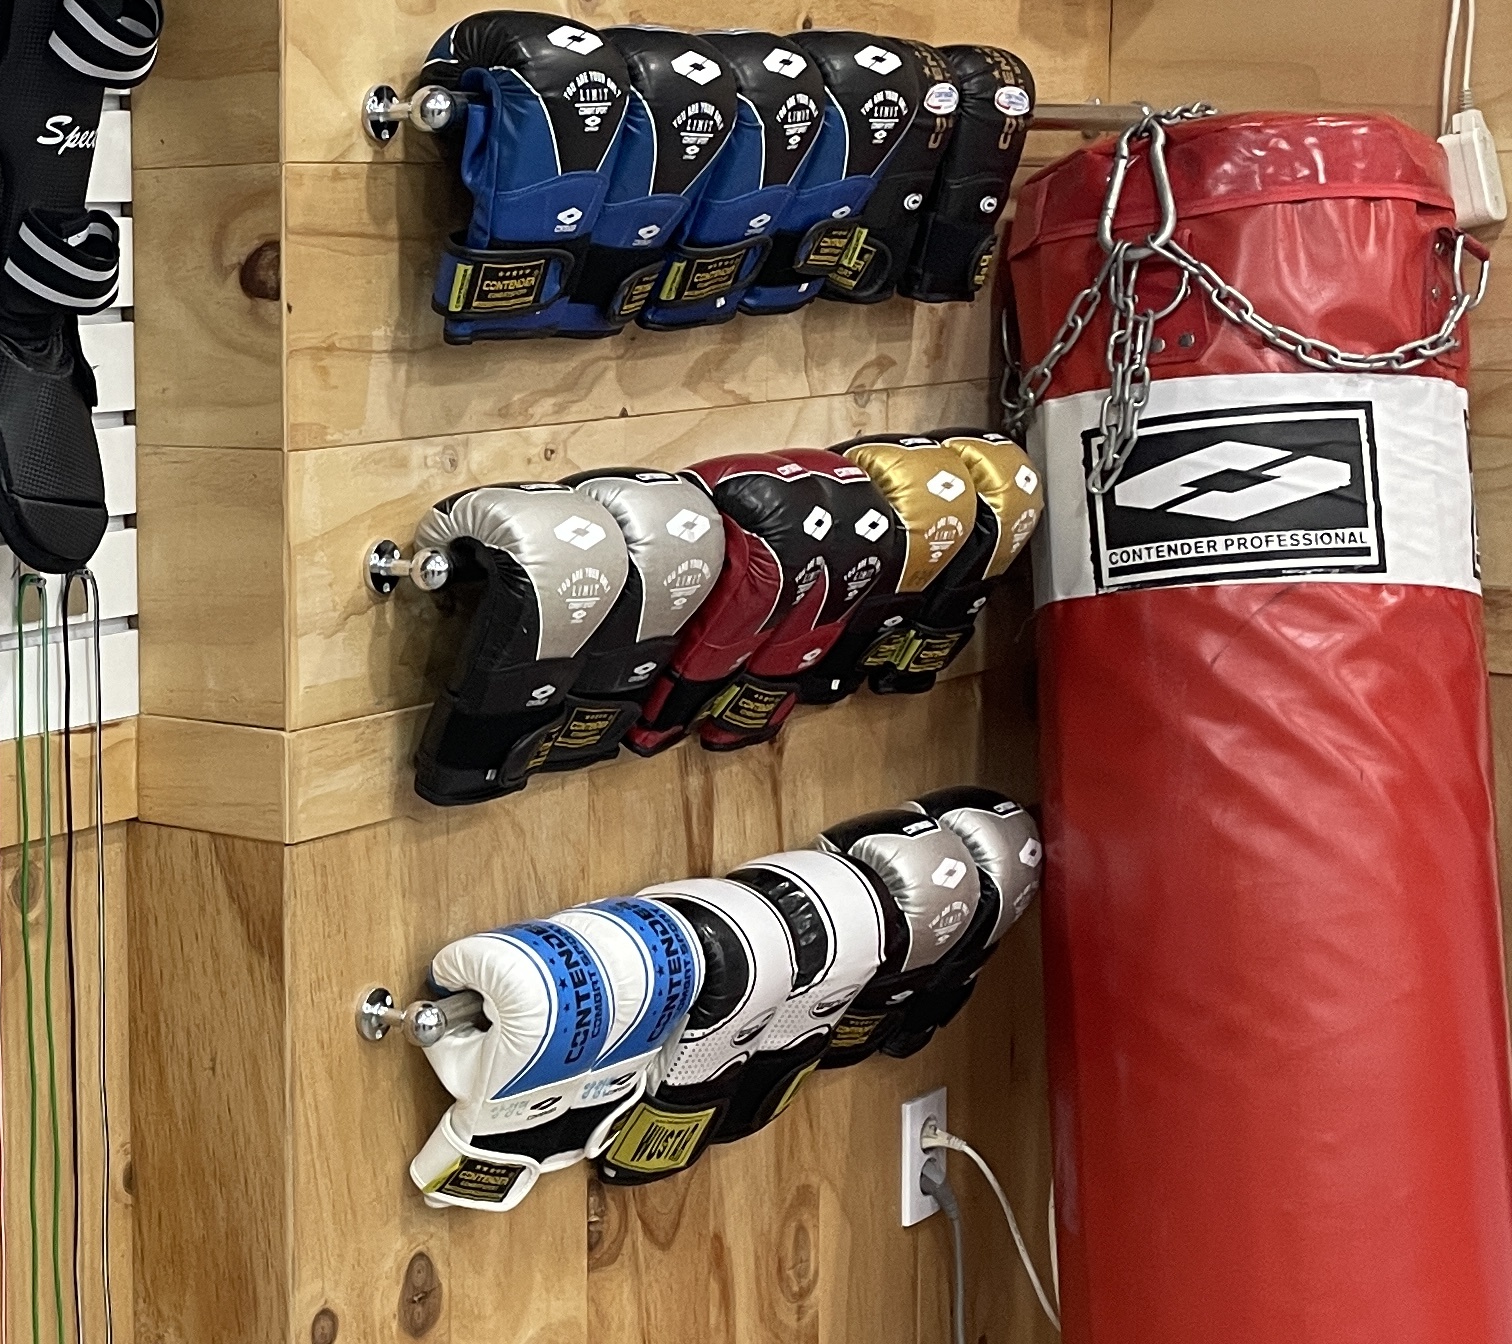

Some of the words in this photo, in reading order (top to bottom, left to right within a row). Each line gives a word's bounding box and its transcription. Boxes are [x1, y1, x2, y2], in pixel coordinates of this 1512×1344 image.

[482, 274, 536, 291] CONTENDER
[1108, 539, 1218, 566] CONTENDER
[1224, 531, 1368, 552] PROFESSIONAL
